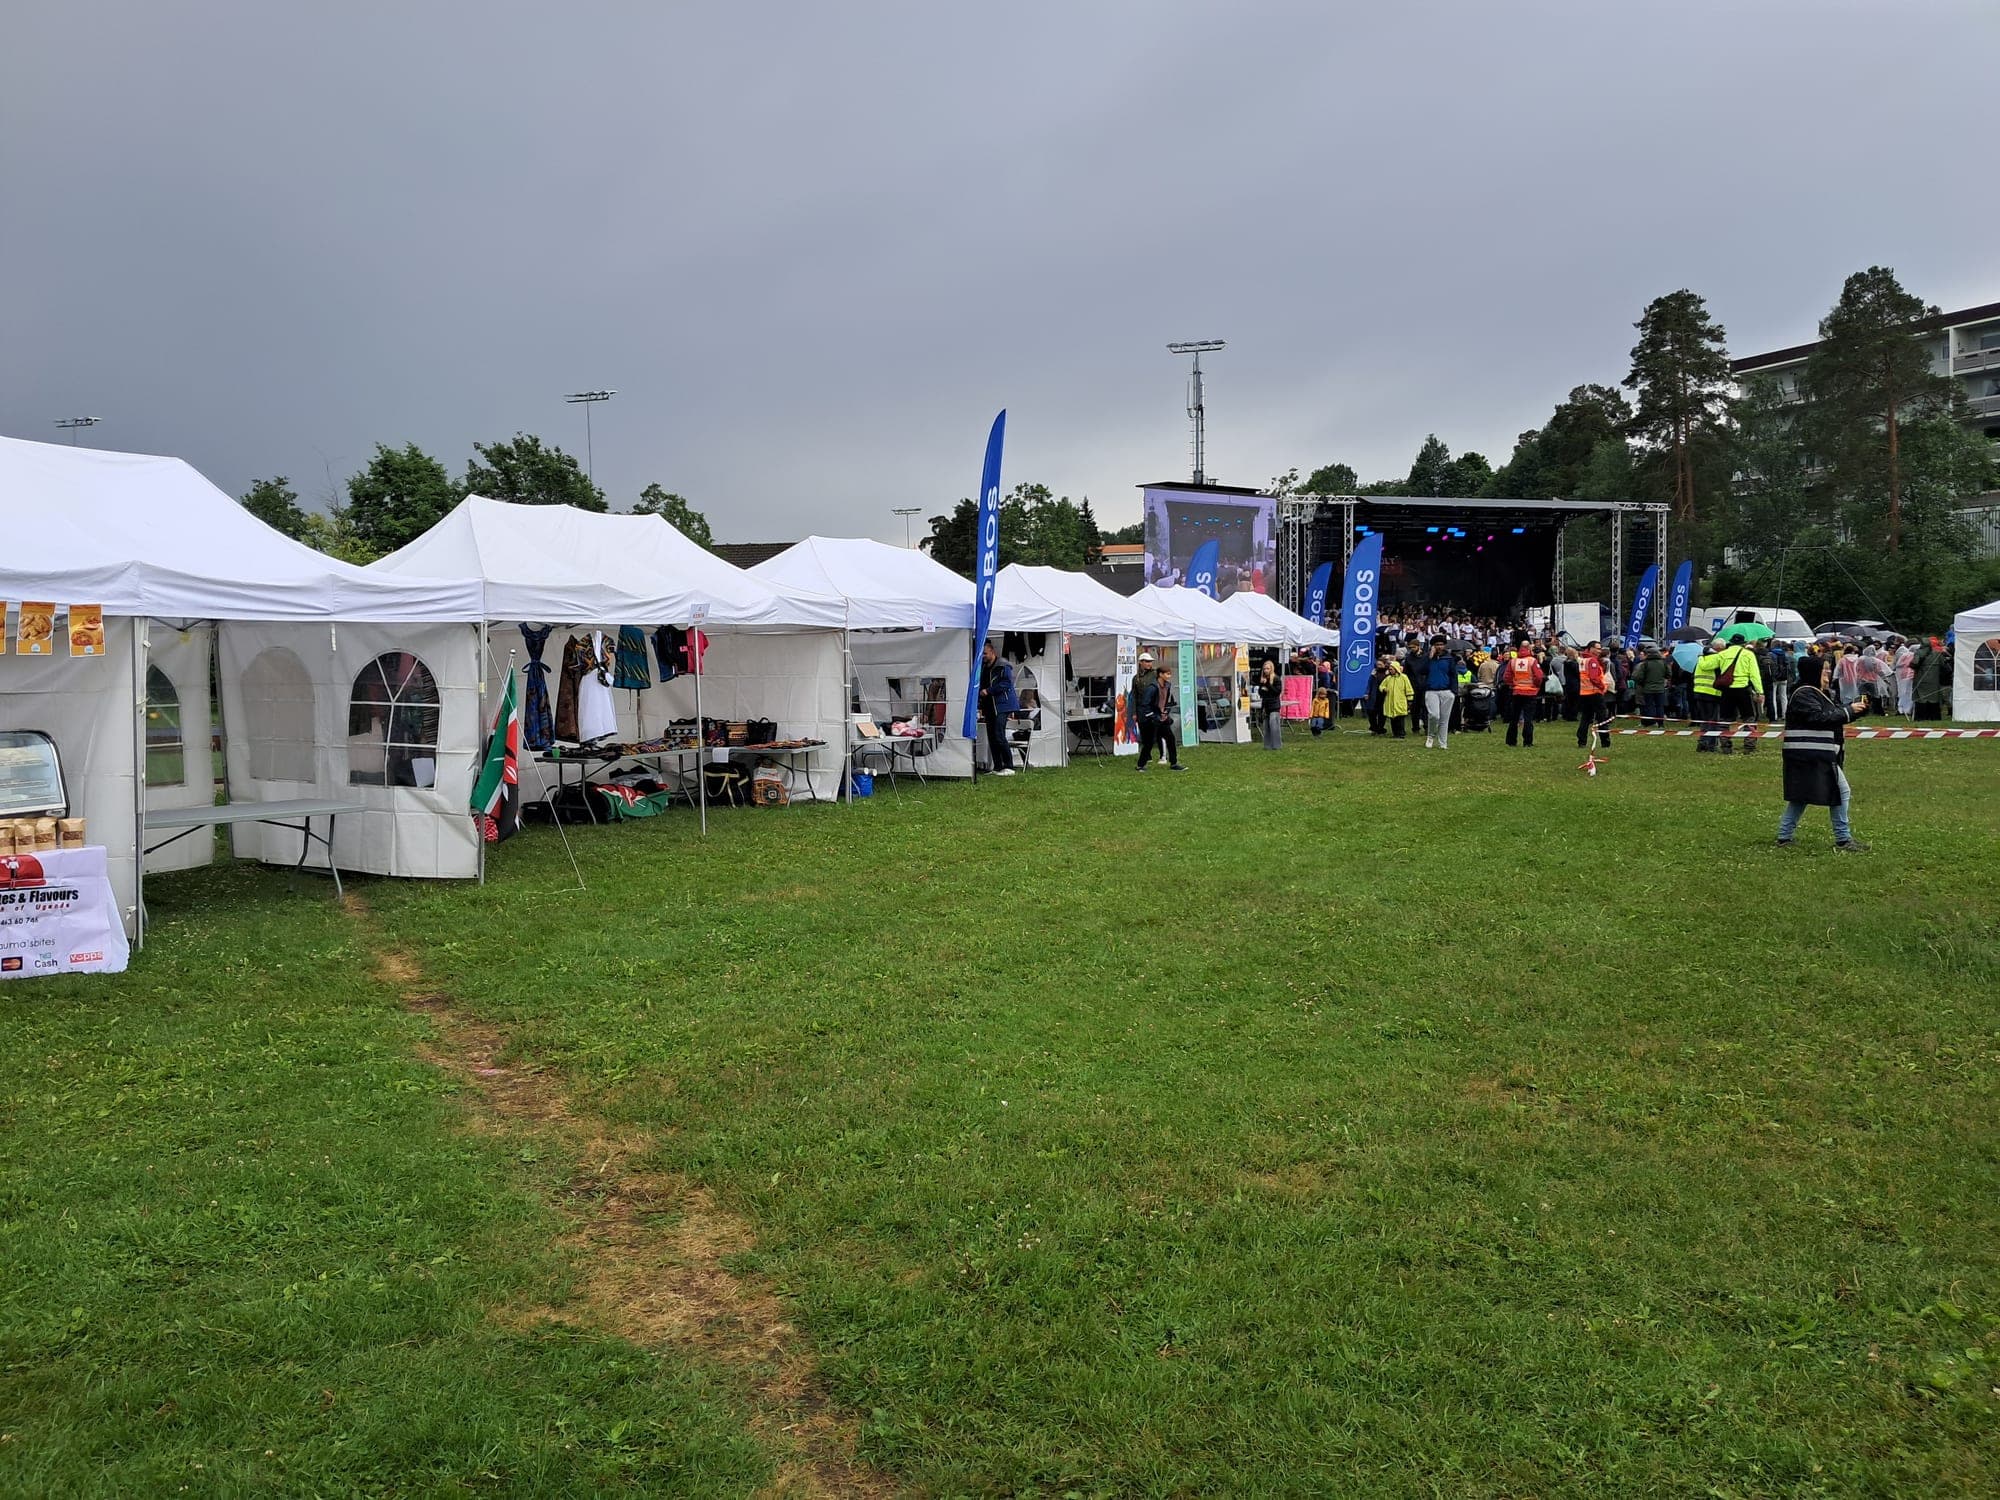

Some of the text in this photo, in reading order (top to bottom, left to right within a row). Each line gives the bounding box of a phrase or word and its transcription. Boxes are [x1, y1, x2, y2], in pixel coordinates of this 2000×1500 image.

[1354, 570, 1374, 635] OBOS
[1632, 587, 1650, 633] OBOS
[1673, 585, 1685, 629] OBOS
[18, 893, 26, 903] &
[29, 890, 79, 903] Flavours
[34, 959, 58, 968] Cash
